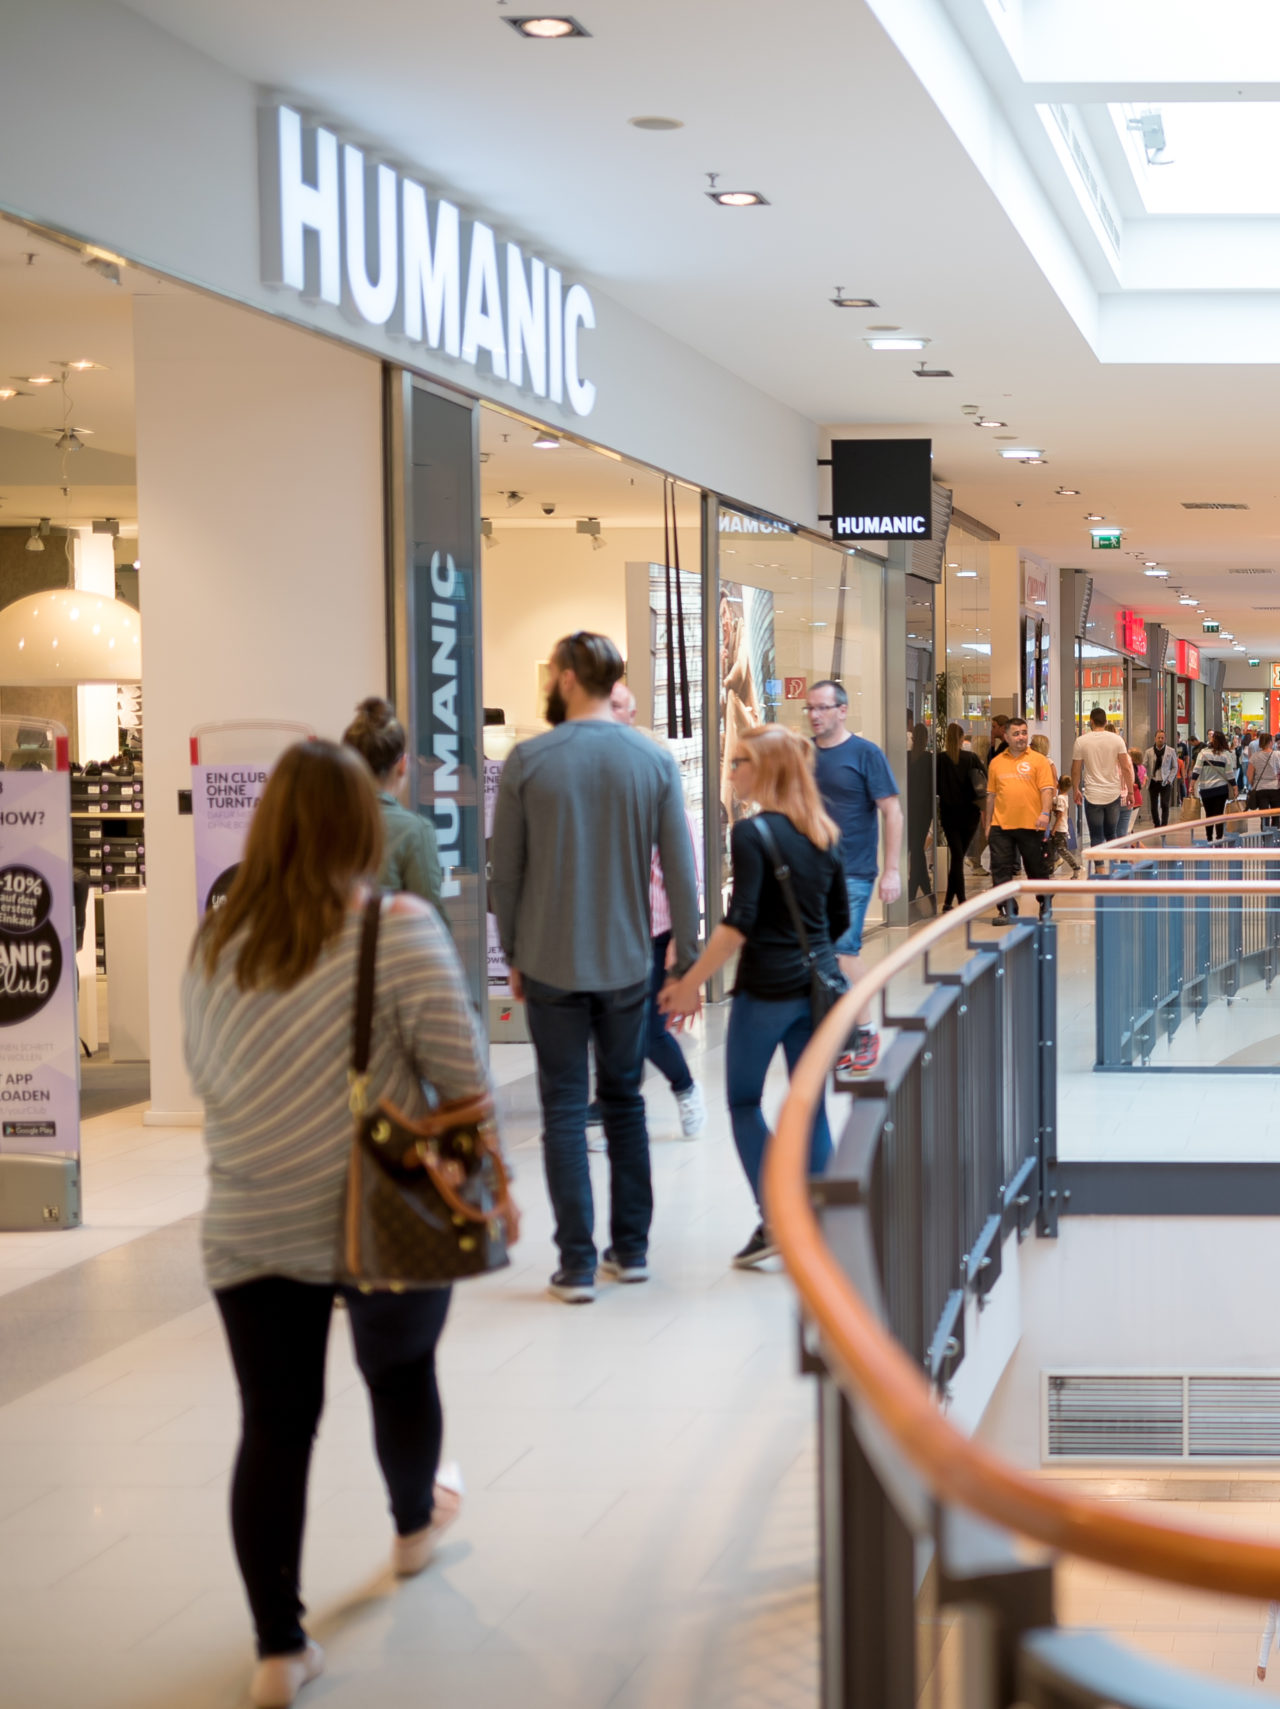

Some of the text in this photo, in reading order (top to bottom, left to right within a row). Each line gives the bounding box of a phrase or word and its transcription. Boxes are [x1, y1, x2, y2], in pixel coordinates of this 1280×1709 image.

[278, 104, 596, 417] HUMANIC
[836, 516, 926, 534] HUMANIC
[431, 550, 462, 898] HUMANIC
[206, 772, 267, 784] EIN CLUB
[206, 785, 246, 796] OHNE
[17, 895, 37, 905] den
[1, 904, 34, 915] ersten
[6, 1073, 33, 1085] APP
[0, 1090, 50, 1101] OADEN
